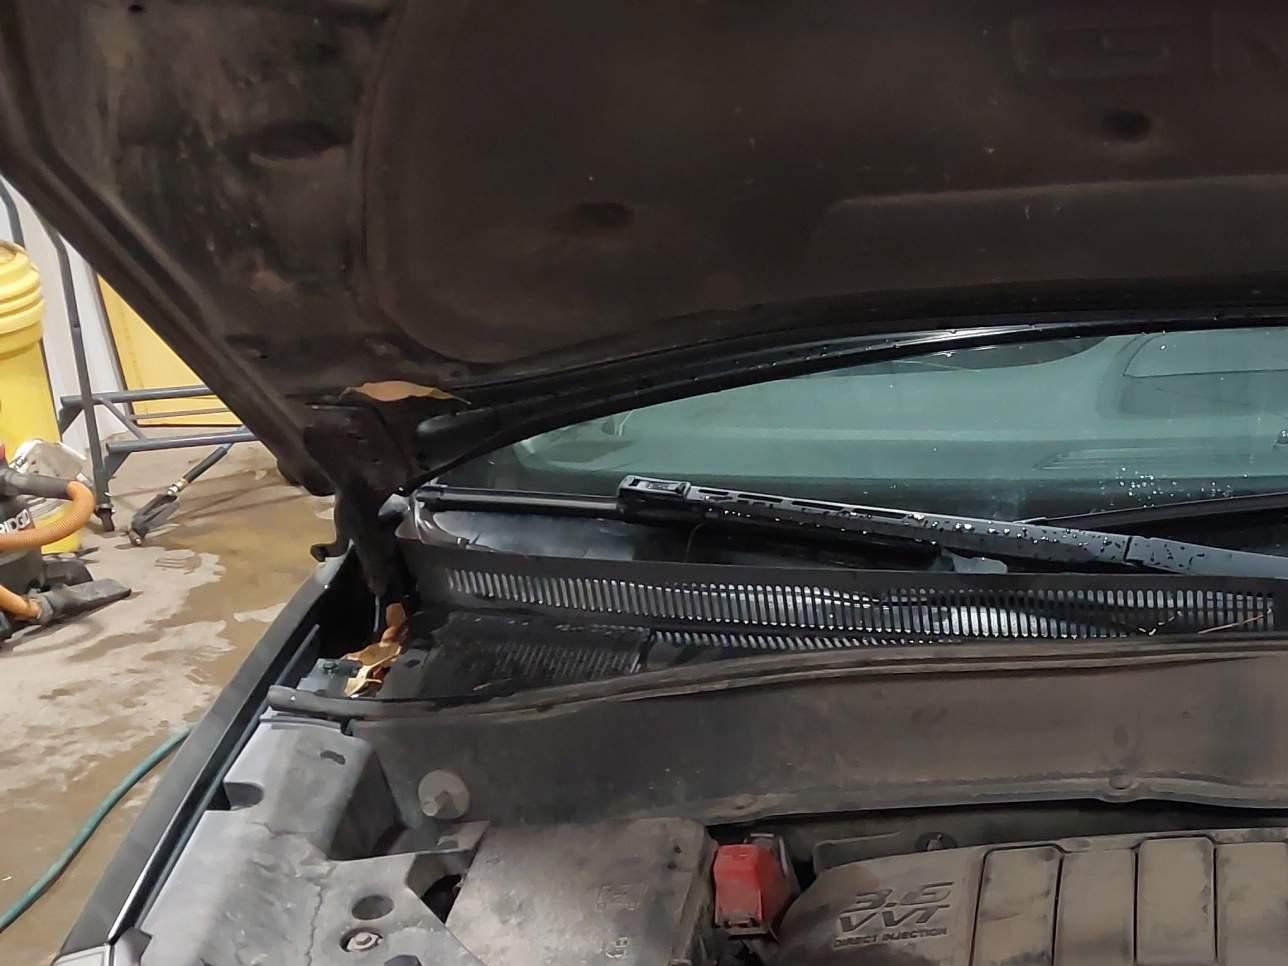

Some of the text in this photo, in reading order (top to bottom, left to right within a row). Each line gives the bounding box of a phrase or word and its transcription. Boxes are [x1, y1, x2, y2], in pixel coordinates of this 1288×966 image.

[840, 881, 955, 914] 3.6
[839, 904, 950, 932] VVT
[833, 927, 948, 948] DIRECT INJECTION
